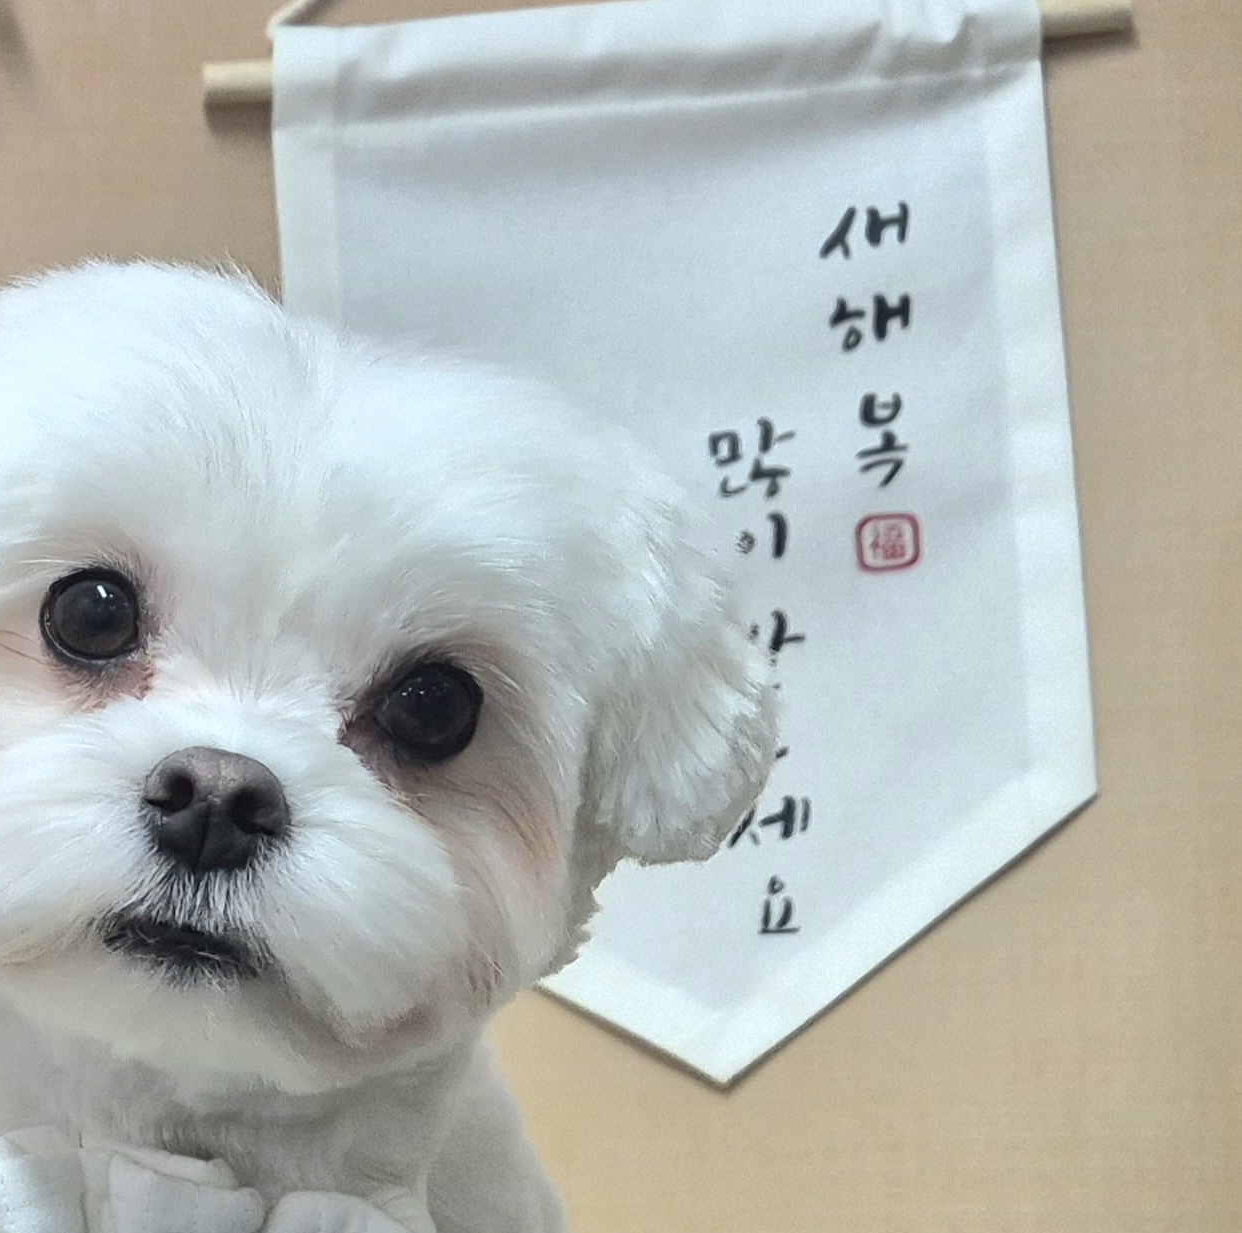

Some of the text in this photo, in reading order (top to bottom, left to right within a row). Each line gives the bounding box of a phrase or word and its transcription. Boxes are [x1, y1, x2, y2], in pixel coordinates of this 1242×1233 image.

[818, 200, 911, 488] 새해 복
[707, 416, 797, 561] 많이
